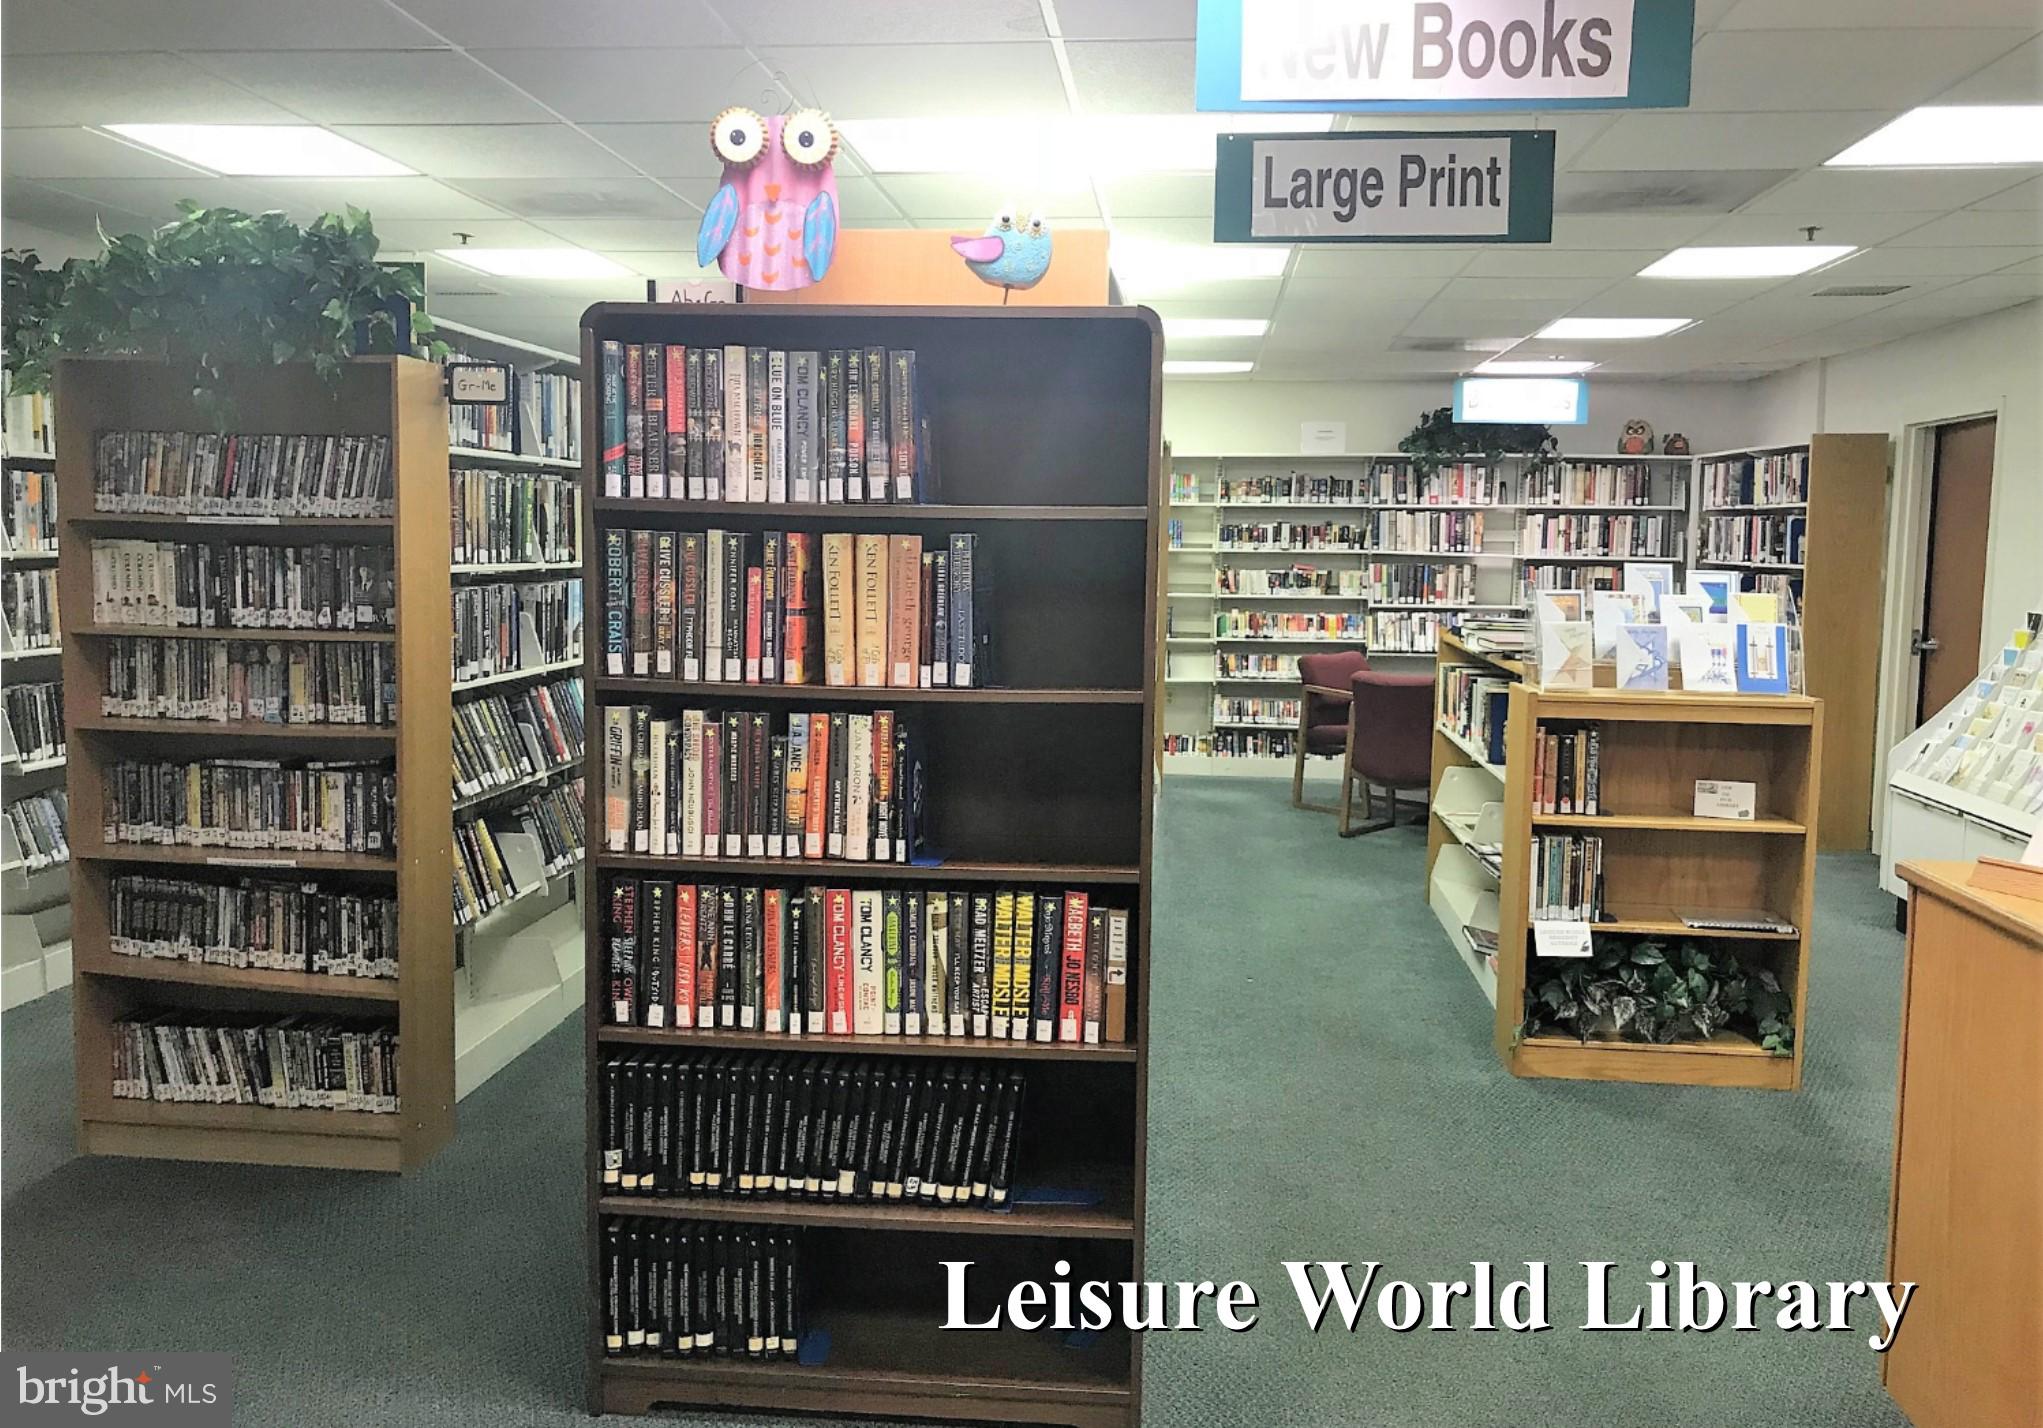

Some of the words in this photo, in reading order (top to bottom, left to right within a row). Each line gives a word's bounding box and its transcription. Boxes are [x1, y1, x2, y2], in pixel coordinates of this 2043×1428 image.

[1412, 0, 1614, 80] Books
[1263, 155, 1384, 223] Large
[1398, 153, 1502, 208] Print
[457, 380, 497, 392] Gr-Me
[771, 386, 782, 401] ON
[771, 404, 782, 431] BLUE
[796, 388, 809, 438] CLANCY
[648, 414, 660, 472] BLAUNER
[848, 442, 860, 474] POISON
[607, 536, 622, 596] ROBERT
[658, 536, 672, 566] CIVE
[828, 544, 840, 570] KEN
[865, 543, 878, 568] KEN
[658, 568, 672, 614] CUSSLER
[828, 570, 841, 623] FOLLETT
[904, 547, 918, 611] elizabeth
[865, 572, 878, 624] FOLLETT
[607, 610, 622, 653] CRAIS
[901, 616, 914, 662] george
[958, 636, 966, 664] TUDO
[609, 726, 623, 766] GRIFFIN
[790, 742, 802, 773] JANCE
[854, 728, 862, 752] JAN
[852, 754, 862, 793] KARON
[636, 810, 644, 830] ISLAN
[624, 885, 634, 934] STEPHEN
[860, 898, 872, 923] TOM
[973, 898, 986, 925] BRAD
[994, 894, 1013, 958] WALTER
[1014, 895, 1034, 958] WALTER
[1066, 898, 1084, 952] MACBETH
[678, 906, 691, 953] LEAVERS
[706, 920, 714, 940] ANN
[722, 924, 734, 936] LE
[744, 928, 752, 950] LEON
[652, 937, 661, 962] KING
[832, 925, 845, 972] CLANCY
[860, 925, 873, 974] CLANCY
[972, 928, 986, 973] MELTZER
[1066, 954, 1082, 970] JO
[650, 970, 660, 1005] OUTSID
[678, 962, 690, 986] LISA
[862, 982, 870, 1012] CONTAC
[972, 982, 981, 1012] ARTIST
